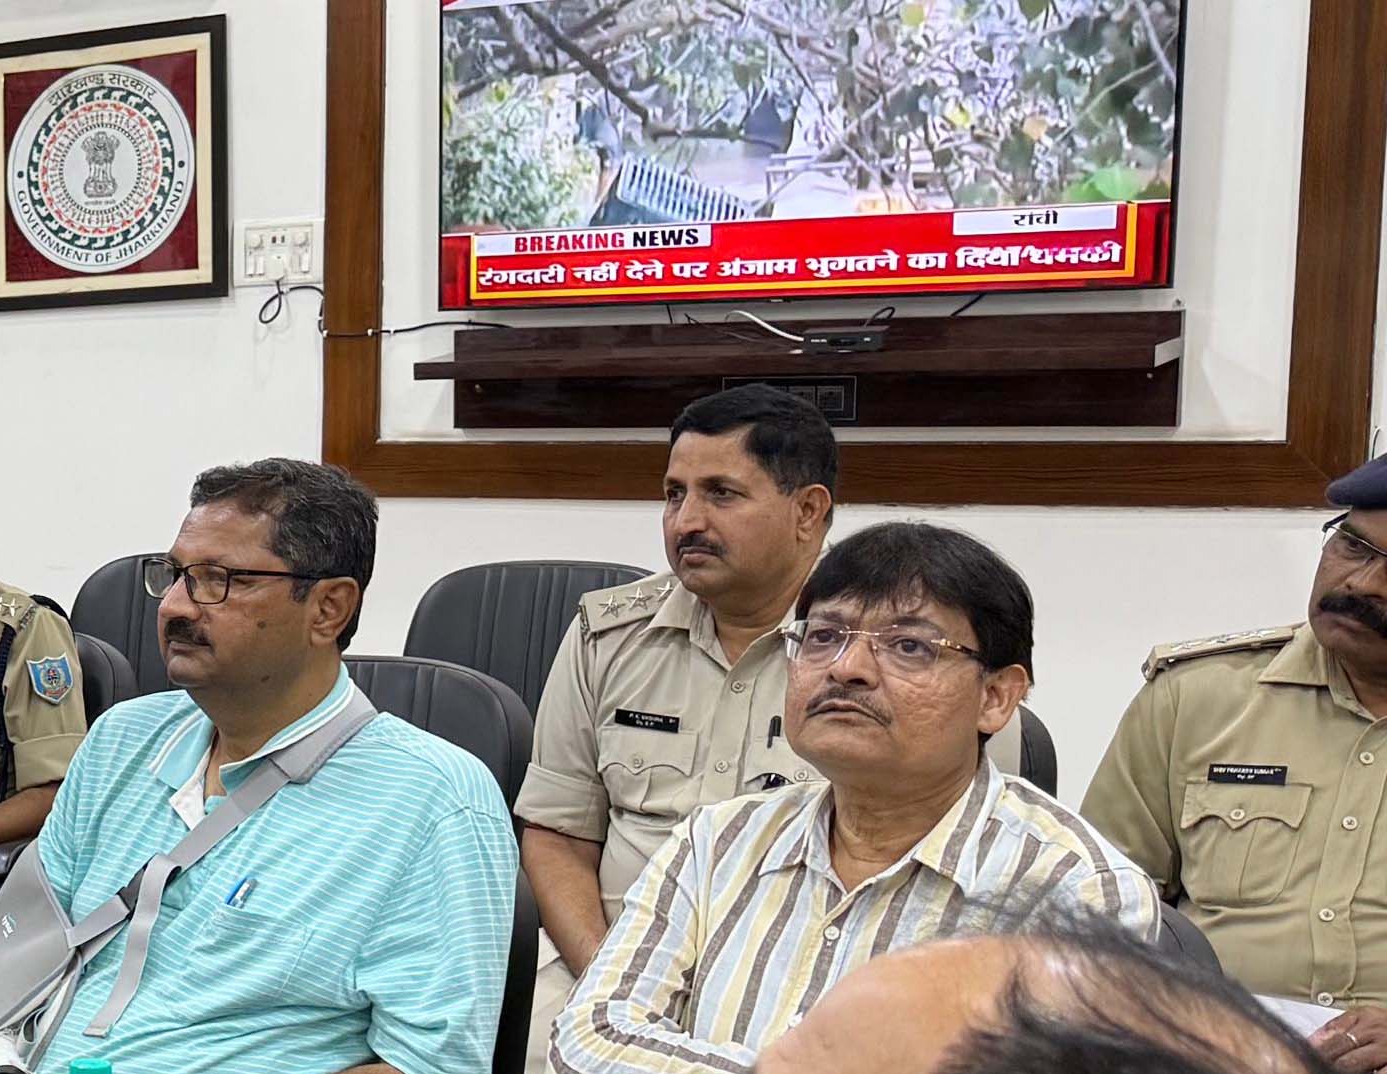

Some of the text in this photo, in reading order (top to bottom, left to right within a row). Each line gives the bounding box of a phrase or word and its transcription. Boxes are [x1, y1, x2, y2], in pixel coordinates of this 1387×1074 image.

[108, 72, 158, 101] सरकार
[17, 180, 185, 263] GOVERNMENT OF JHARKHAND
[515, 228, 699, 253] BREAKING NEWS
[478, 263, 566, 286] रंगदारी
[572, 261, 620, 282] नहीं
[625, 259, 664, 281] देने
[670, 261, 709, 278] पर
[717, 256, 797, 277] अंजाम
[805, 248, 900, 278] भुगतने
[906, 251, 948, 270] का
